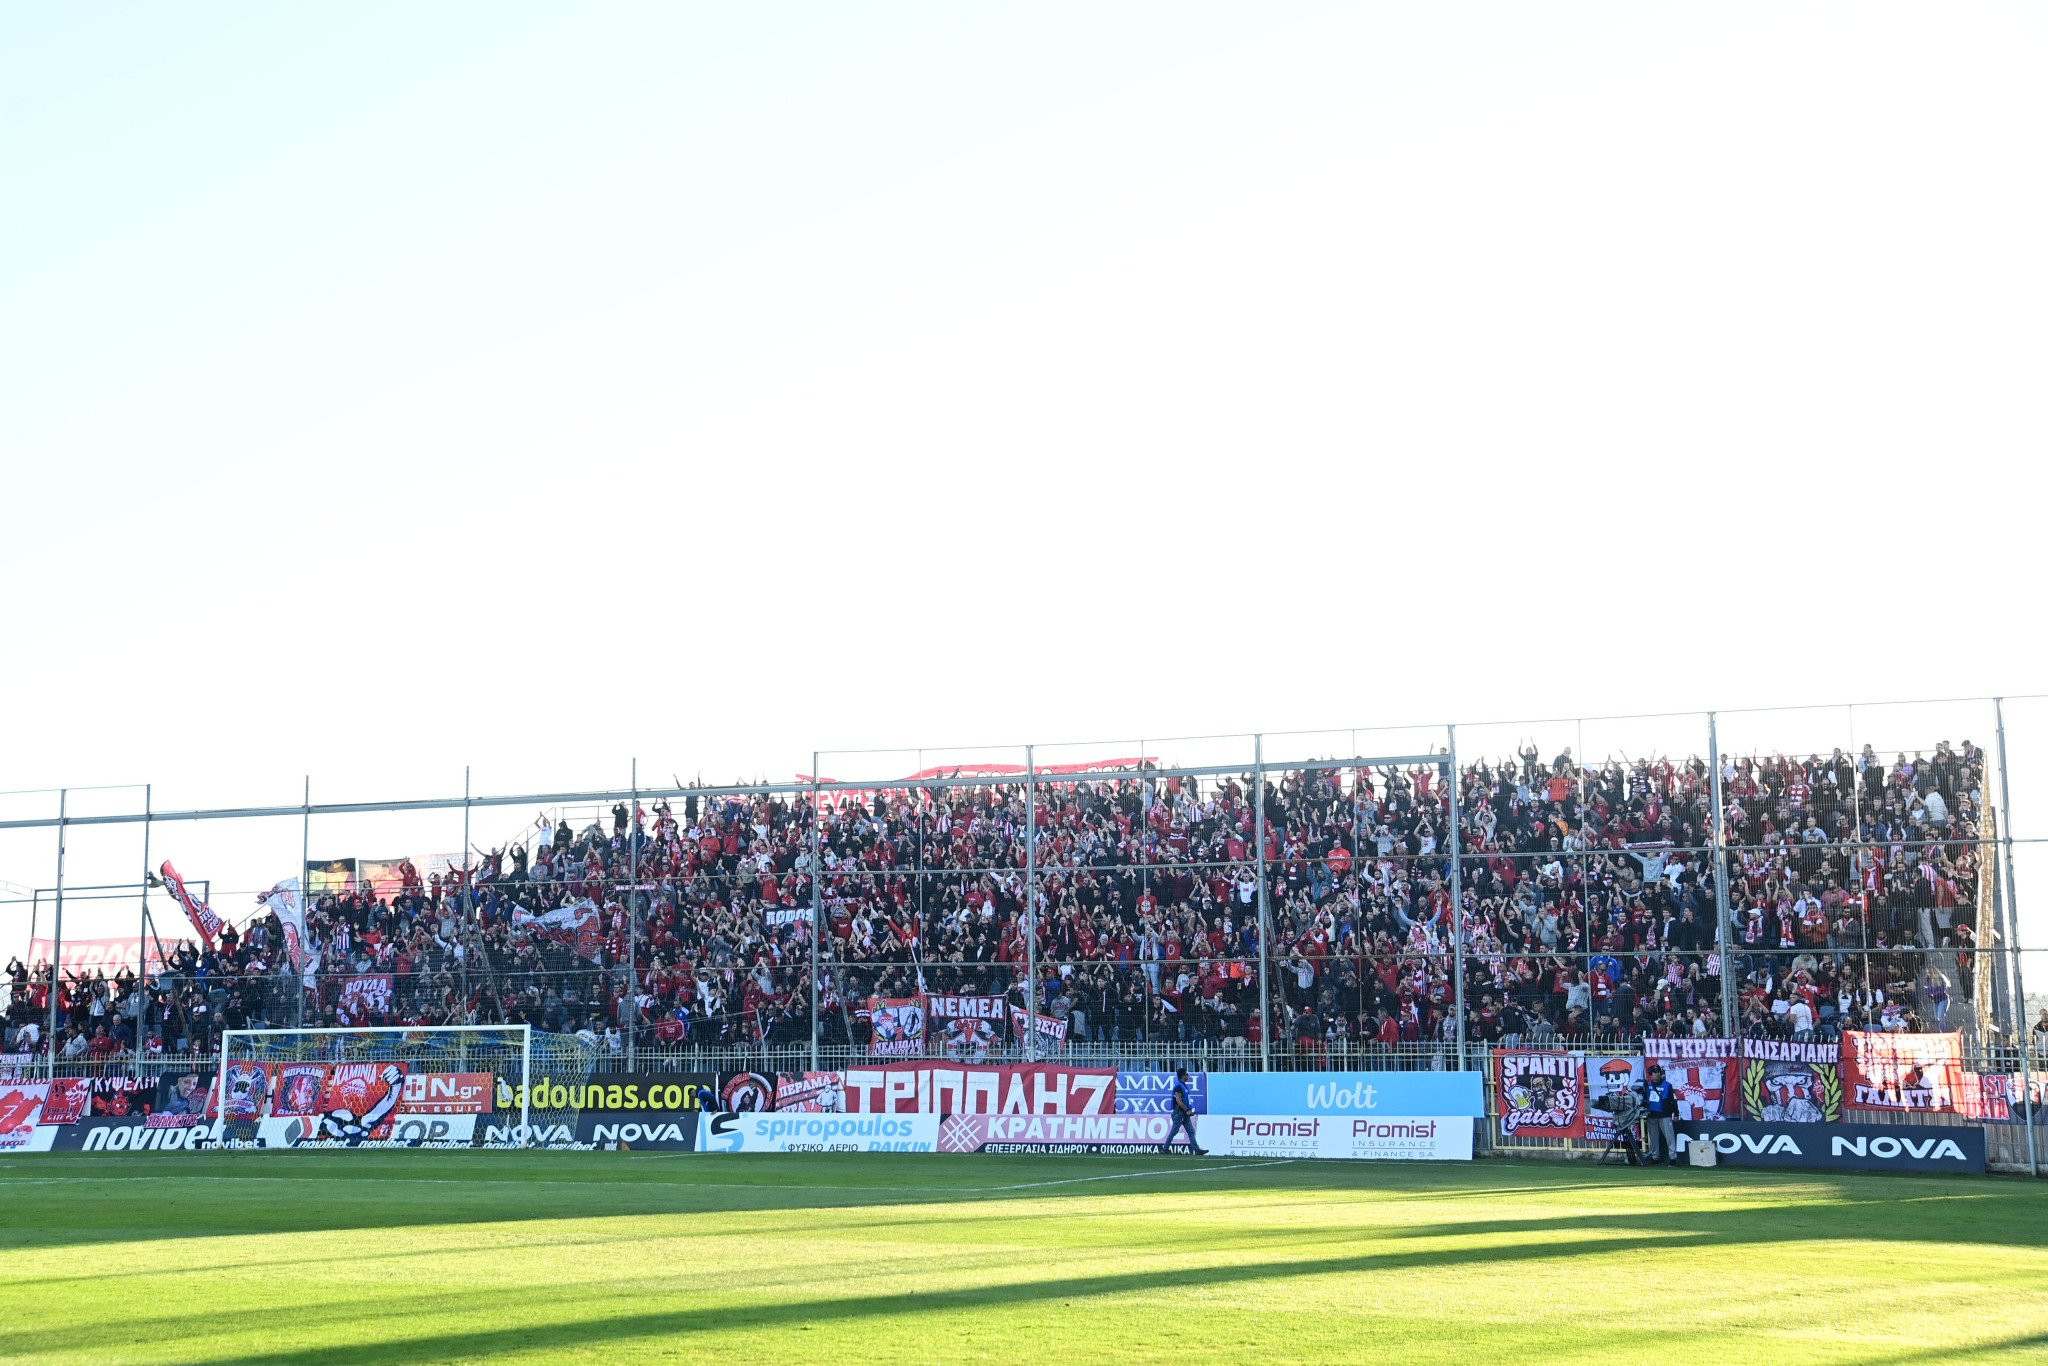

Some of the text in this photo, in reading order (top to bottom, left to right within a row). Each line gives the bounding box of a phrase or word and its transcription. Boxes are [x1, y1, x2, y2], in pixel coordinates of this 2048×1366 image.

[1644, 1038, 1737, 1057] ΠΑΓΚΡΑΤΙ
[1743, 1039, 1839, 1063] ΚΑΙΣΑΡΙΑΝΗ
[0, 1053, 33, 1064] ERISTERI
[1503, 1054, 1575, 1078] SPARTI
[778, 1074, 832, 1098] ΠΕΡΑΜΑ
[1306, 1081, 1378, 1110] Wolt
[433, 1105, 482, 1113] EQUIP
[1231, 1117, 1320, 1137] Promist
[1507, 1109, 1577, 1130] gate 7
[484, 1124, 574, 1142] NOVA
[593, 1123, 685, 1142] NOVA
[755, 1114, 913, 1142] spiropoulos
[1352, 1119, 1437, 1138] Promist
[299, 1137, 351, 1149] novibet
[357, 1138, 411, 1149] novibet
[420, 1139, 474, 1149] novibet
[482, 1139, 536, 1149] novibt
[787, 1142, 859, 1152] ΦΥΣΙΚΟ ΑΕΡΙΟ
[867, 1141, 932, 1152] DAIKIN
[985, 1143, 1047, 1154] ΕΠΕΞΕΡΓΑΣΙΑ
[1049, 1144, 1088, 1154] ΣΙΔΗΡΟΥ
[1100, 1144, 1160, 1155] ΟΙΚΟΔΟΜΙΚΑ
[1229, 1139, 1319, 1147] INSURANCE
[1352, 1140, 1436, 1148] INSURANCE
[1676, 1132, 1803, 1155] NOVA
[1832, 1136, 1968, 1161] NOVA
[1241, 1150, 1295, 1158] FINANCE
[1363, 1150, 1413, 1158] FINANCE
